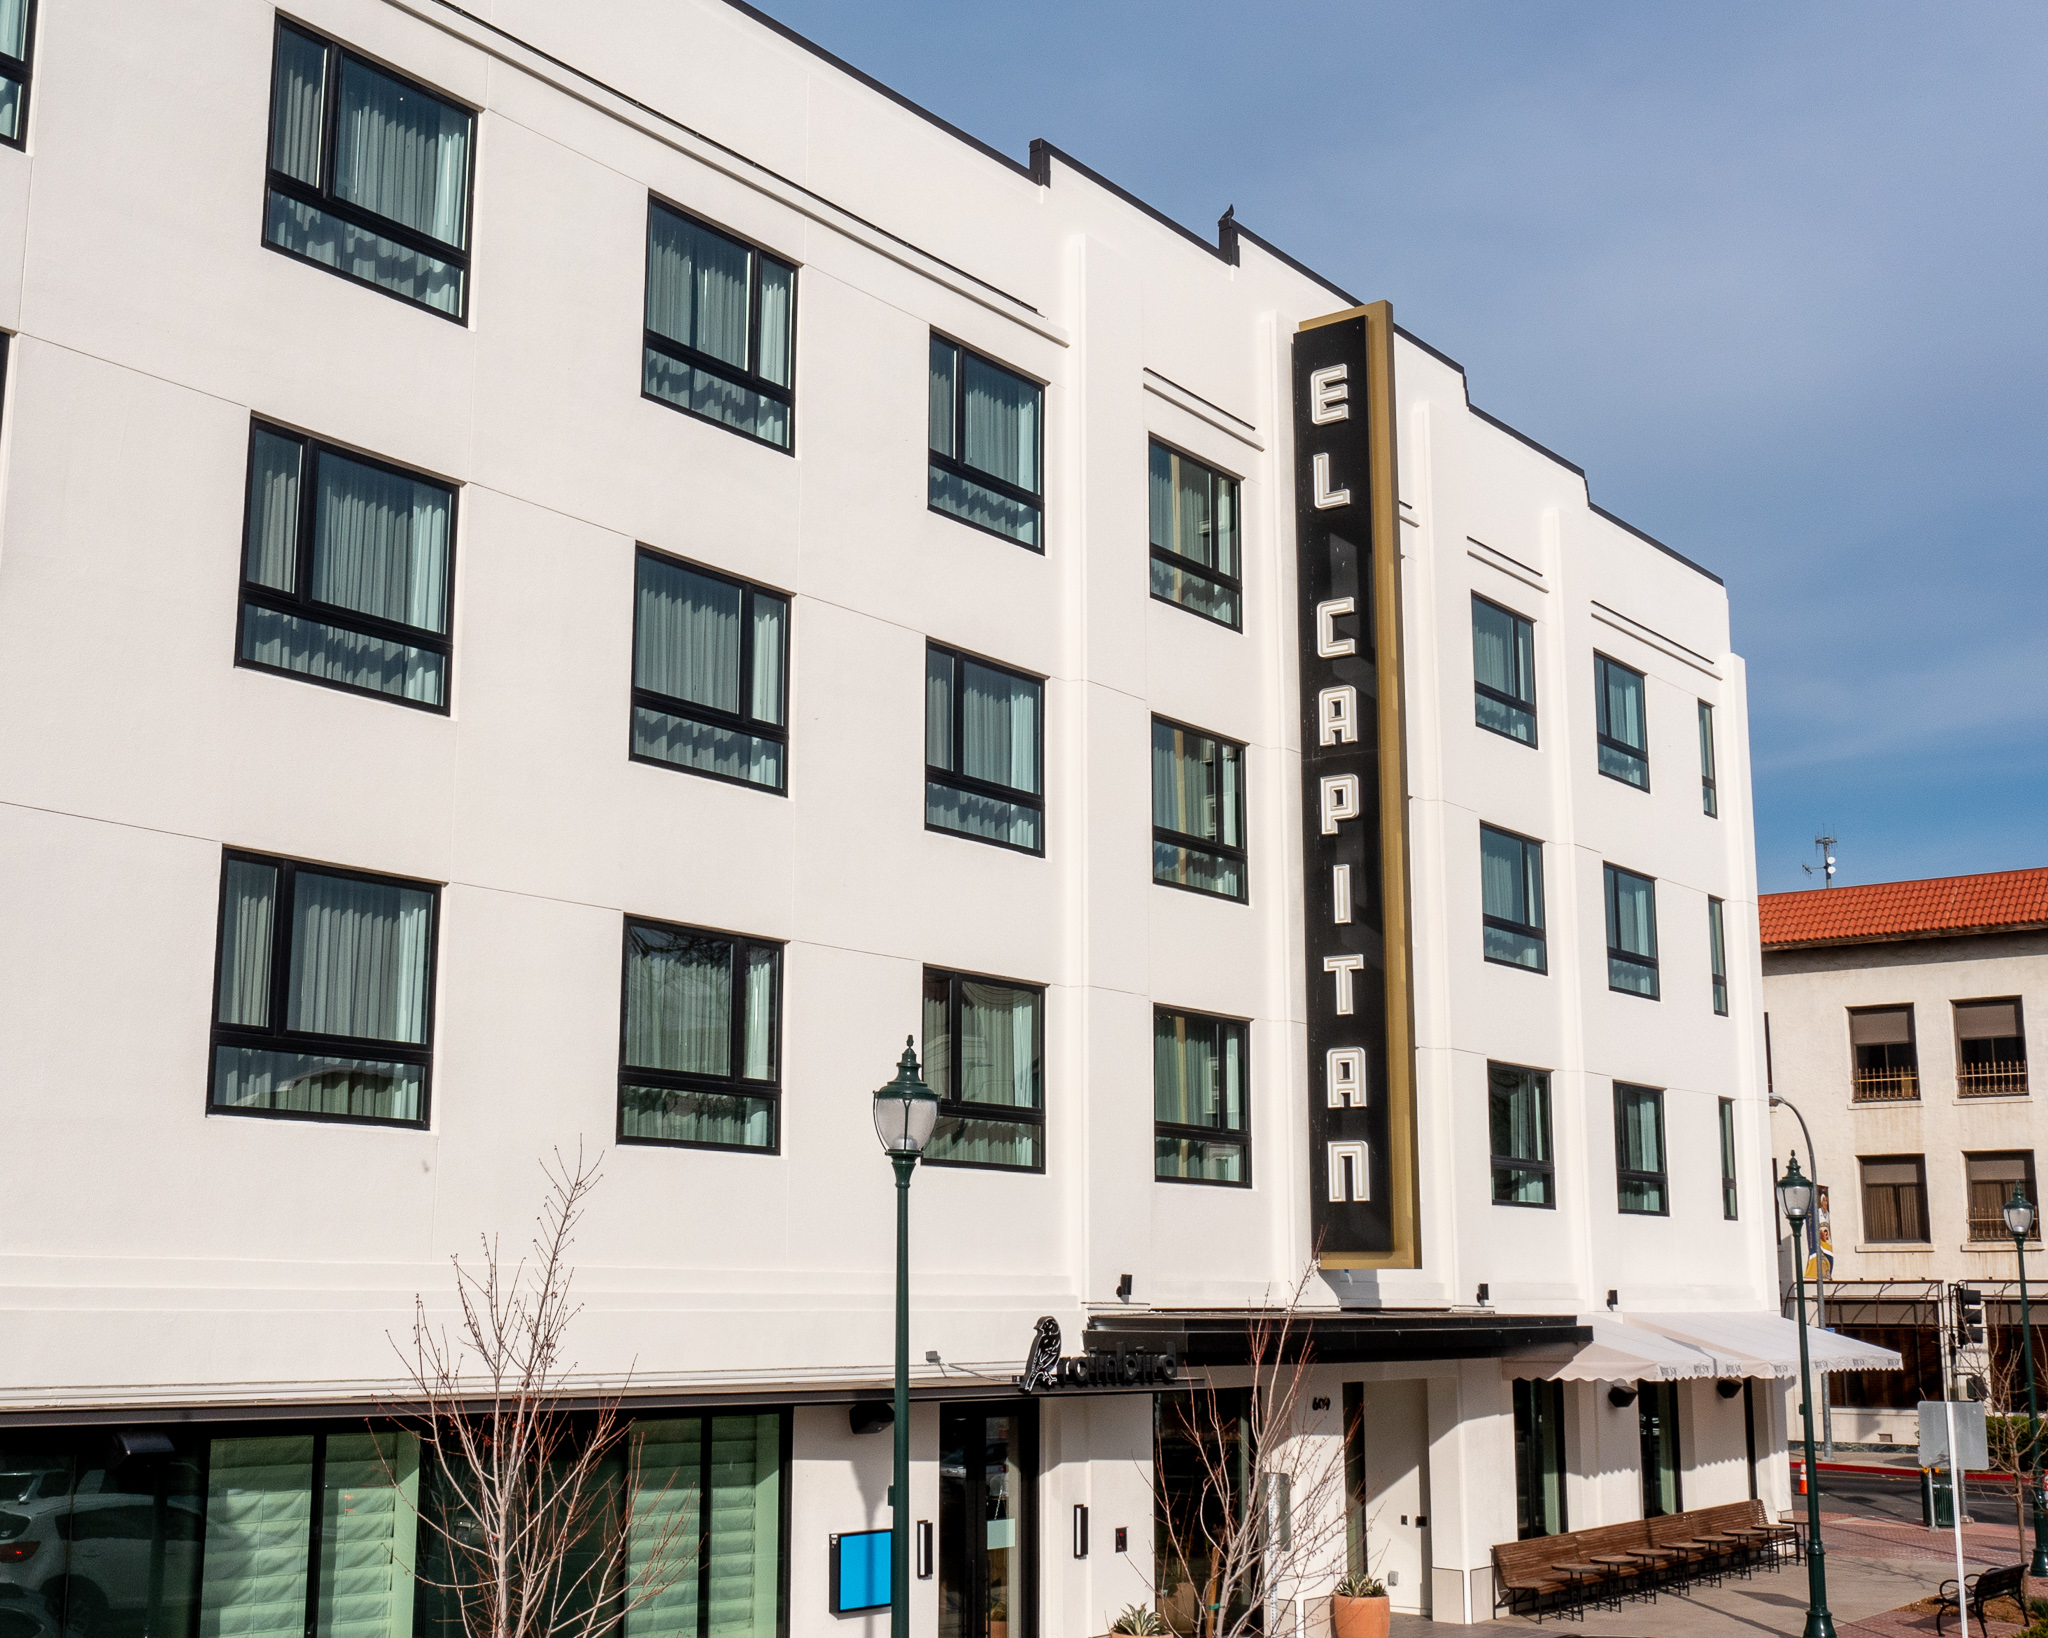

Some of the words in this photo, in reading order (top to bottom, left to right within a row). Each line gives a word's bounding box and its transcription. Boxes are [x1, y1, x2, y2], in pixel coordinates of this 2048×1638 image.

[1310, 363, 1351, 510] EL
[1316, 596, 1371, 1202] CAPITAN
[1057, 1341, 1177, 1383] rainbird
